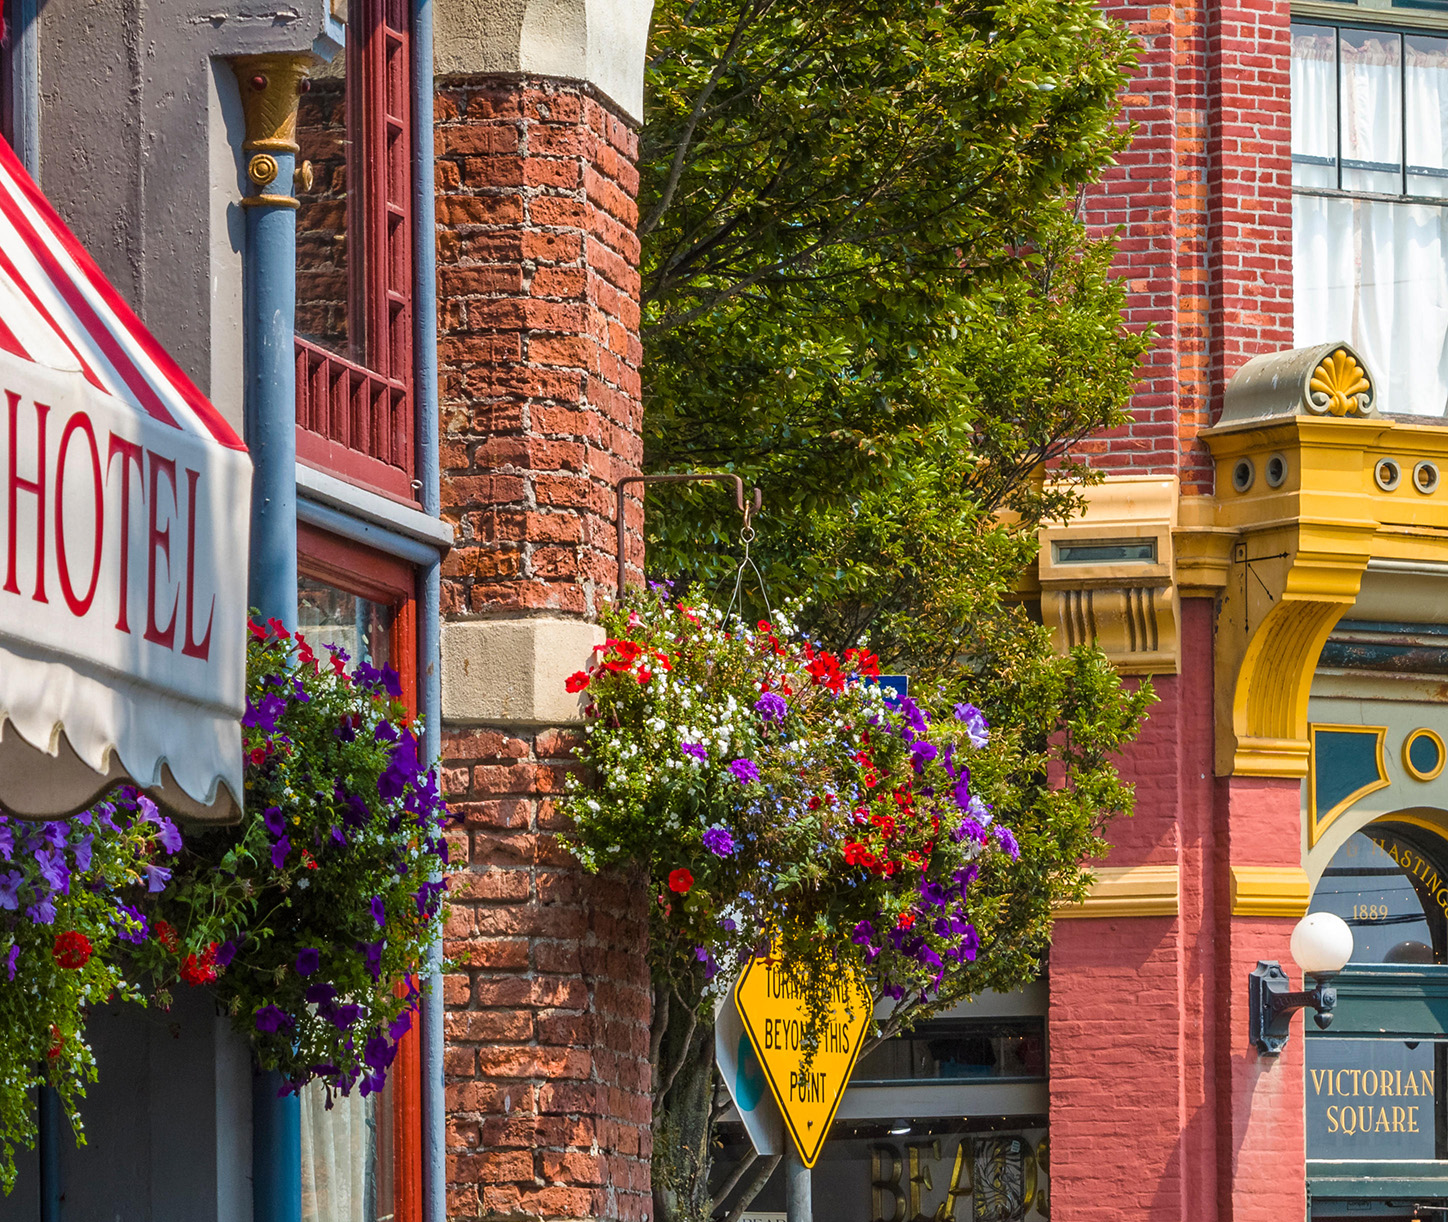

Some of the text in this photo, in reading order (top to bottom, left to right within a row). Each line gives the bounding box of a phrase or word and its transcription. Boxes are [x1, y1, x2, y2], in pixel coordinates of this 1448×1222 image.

[3, 388, 216, 662] HOTEL
[1352, 904, 1388, 921] 1889
[823, 1022, 850, 1054] THIS
[789, 1071, 827, 1103] POINT
[1309, 1069, 1435, 1098] VICTORIAN
[1326, 1105, 1420, 1136] SQUARE
